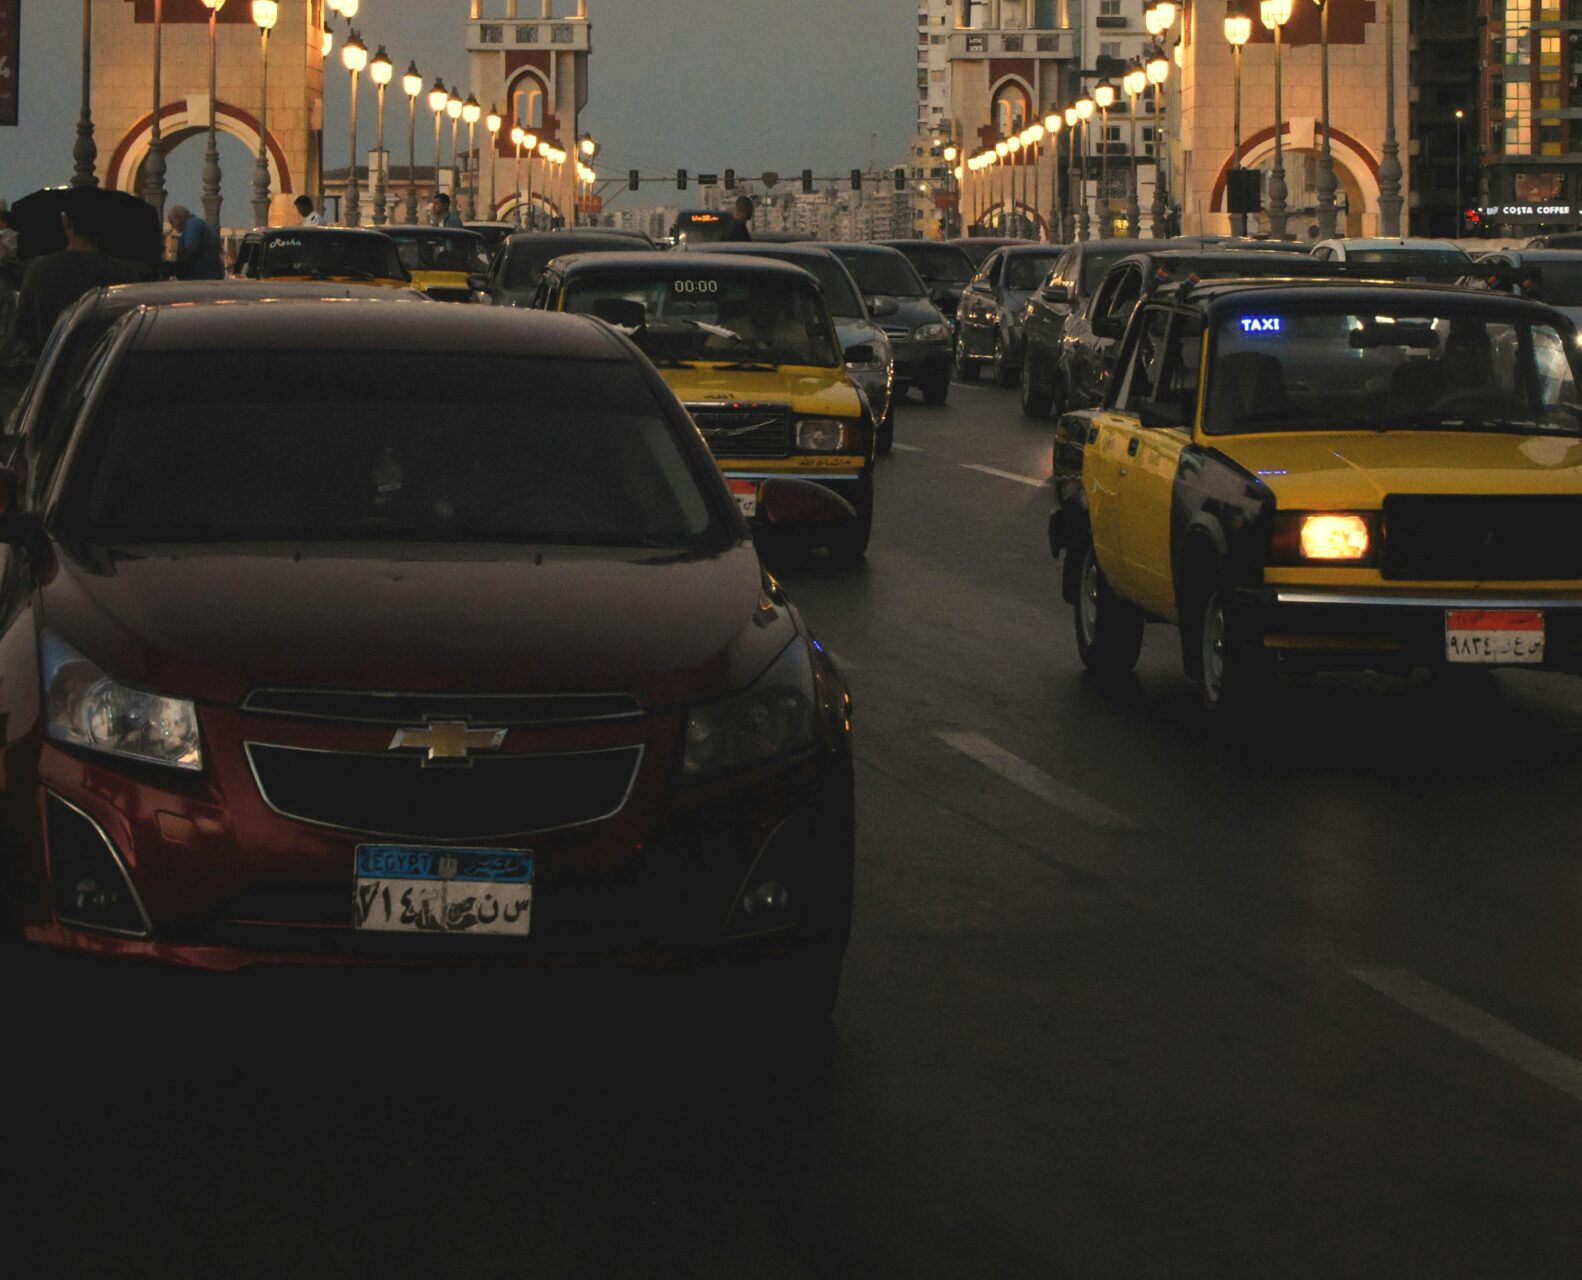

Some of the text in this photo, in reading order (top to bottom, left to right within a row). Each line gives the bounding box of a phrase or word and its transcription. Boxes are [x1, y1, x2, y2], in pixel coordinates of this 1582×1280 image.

[1502, 206, 1533, 215] COSTA
[1537, 206, 1570, 214] COFFEE
[674, 280, 717, 292] 00:00
[1241, 318, 1280, 331] TAXI
[372, 852, 432, 871] EGYPT
